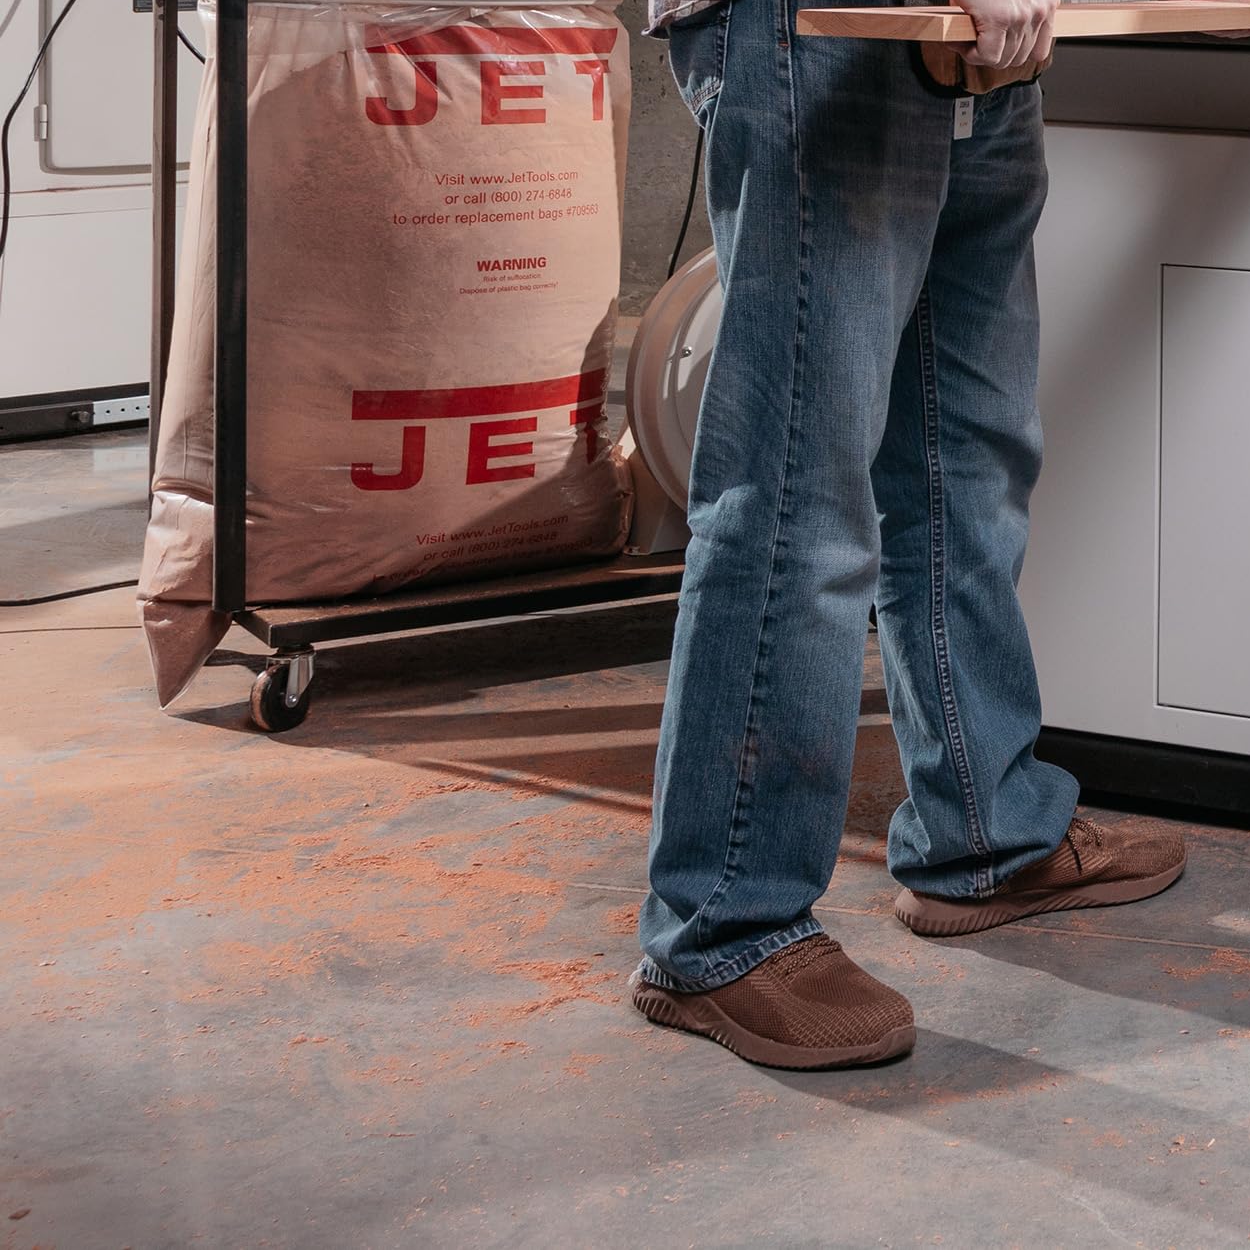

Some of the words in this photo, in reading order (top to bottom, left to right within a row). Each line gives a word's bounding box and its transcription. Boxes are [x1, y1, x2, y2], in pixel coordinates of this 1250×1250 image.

[365, 59, 610, 126] JET
[435, 174, 464, 186] Visit
[470, 171, 579, 185] www.JetTools.com
[445, 196, 459, 205] or
[463, 192, 486, 205] call
[491, 190, 522, 204] (800)
[526, 188, 572, 202] 274-6848
[393, 214, 407, 225] to
[412, 213, 450, 225] order
[455, 211, 534, 226] replacement
[538, 209, 563, 221] bags
[477, 257, 547, 272] WARNING
[460, 287, 487, 295] Dispose
[497, 285, 519, 293] plastic
[520, 284, 531, 292] bag
[350, 402, 607, 490] JET
[416, 533, 446, 546] Visit
[450, 515, 568, 541] www.JetTools.com
[441, 547, 464, 559] call
